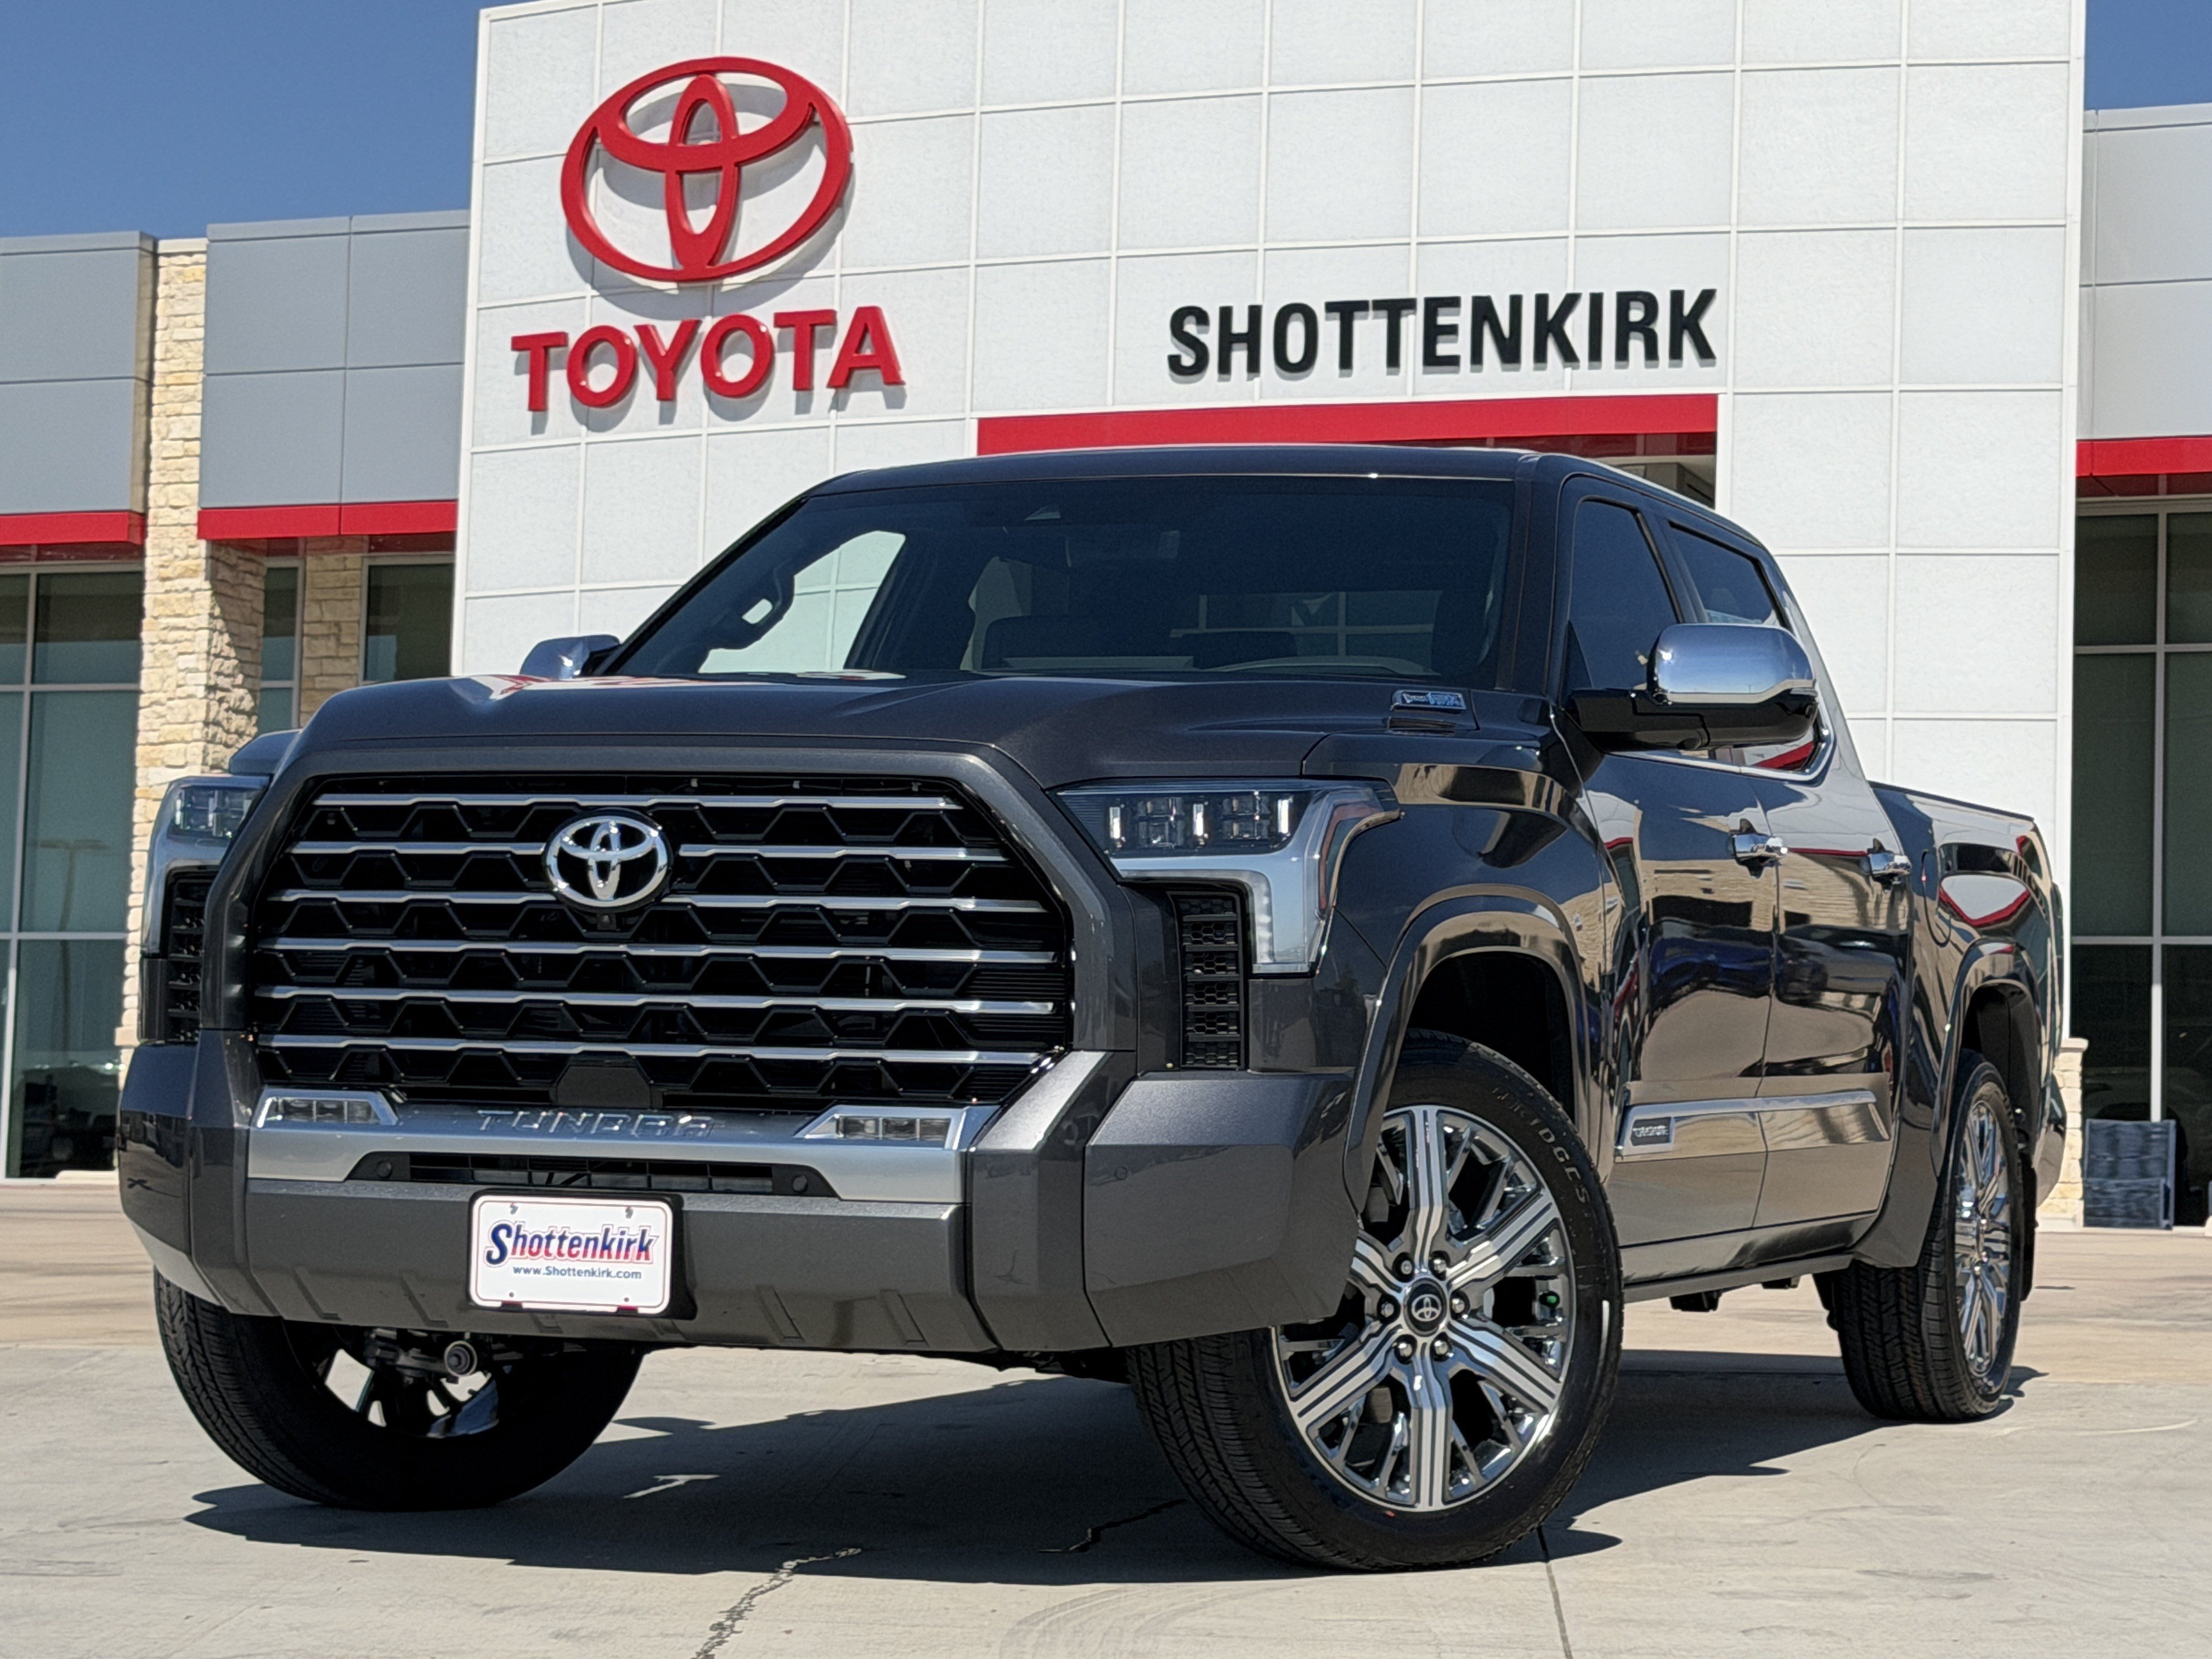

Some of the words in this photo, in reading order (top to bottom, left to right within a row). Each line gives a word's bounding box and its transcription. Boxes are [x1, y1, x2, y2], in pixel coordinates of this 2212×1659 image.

[511, 306, 906, 412] TOYOTA
[1167, 289, 1717, 379] SHOTTENKIRK
[486, 1222, 654, 1265] Shottenkirk
[513, 1265, 642, 1280] www.Shottenkirk.com
